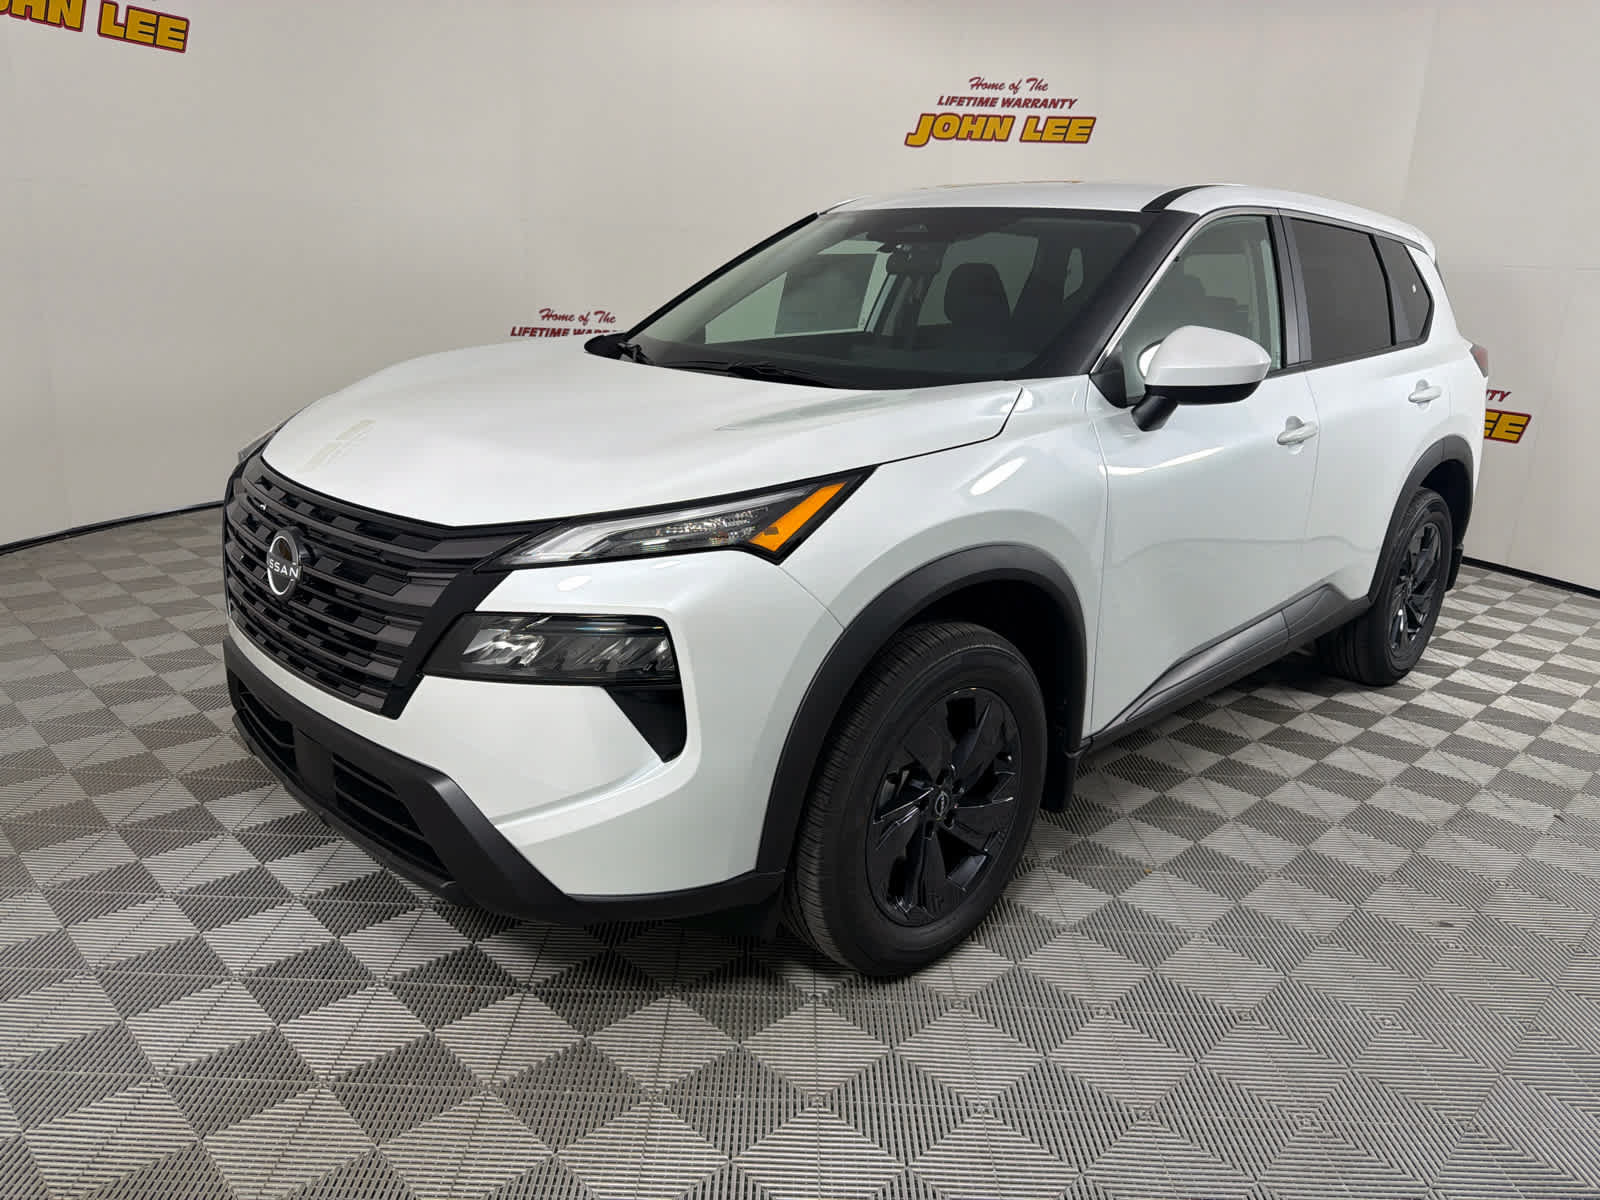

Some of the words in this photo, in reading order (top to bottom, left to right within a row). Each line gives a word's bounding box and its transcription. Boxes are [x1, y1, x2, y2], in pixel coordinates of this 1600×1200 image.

[97, 0, 190, 53] LEE
[968, 76, 1006, 91] Home
[1008, 79, 1022, 94] of
[1026, 77, 1049, 92] The
[937, 95, 999, 108] LIFETIME
[1000, 97, 1078, 110] WARRANTY
[904, 113, 1016, 147] JOHN
[1019, 115, 1097, 144] LEE
[538, 307, 576, 322] Home
[578, 311, 591, 326] of
[594, 309, 617, 324] The
[510, 325, 570, 337] LIFETIME
